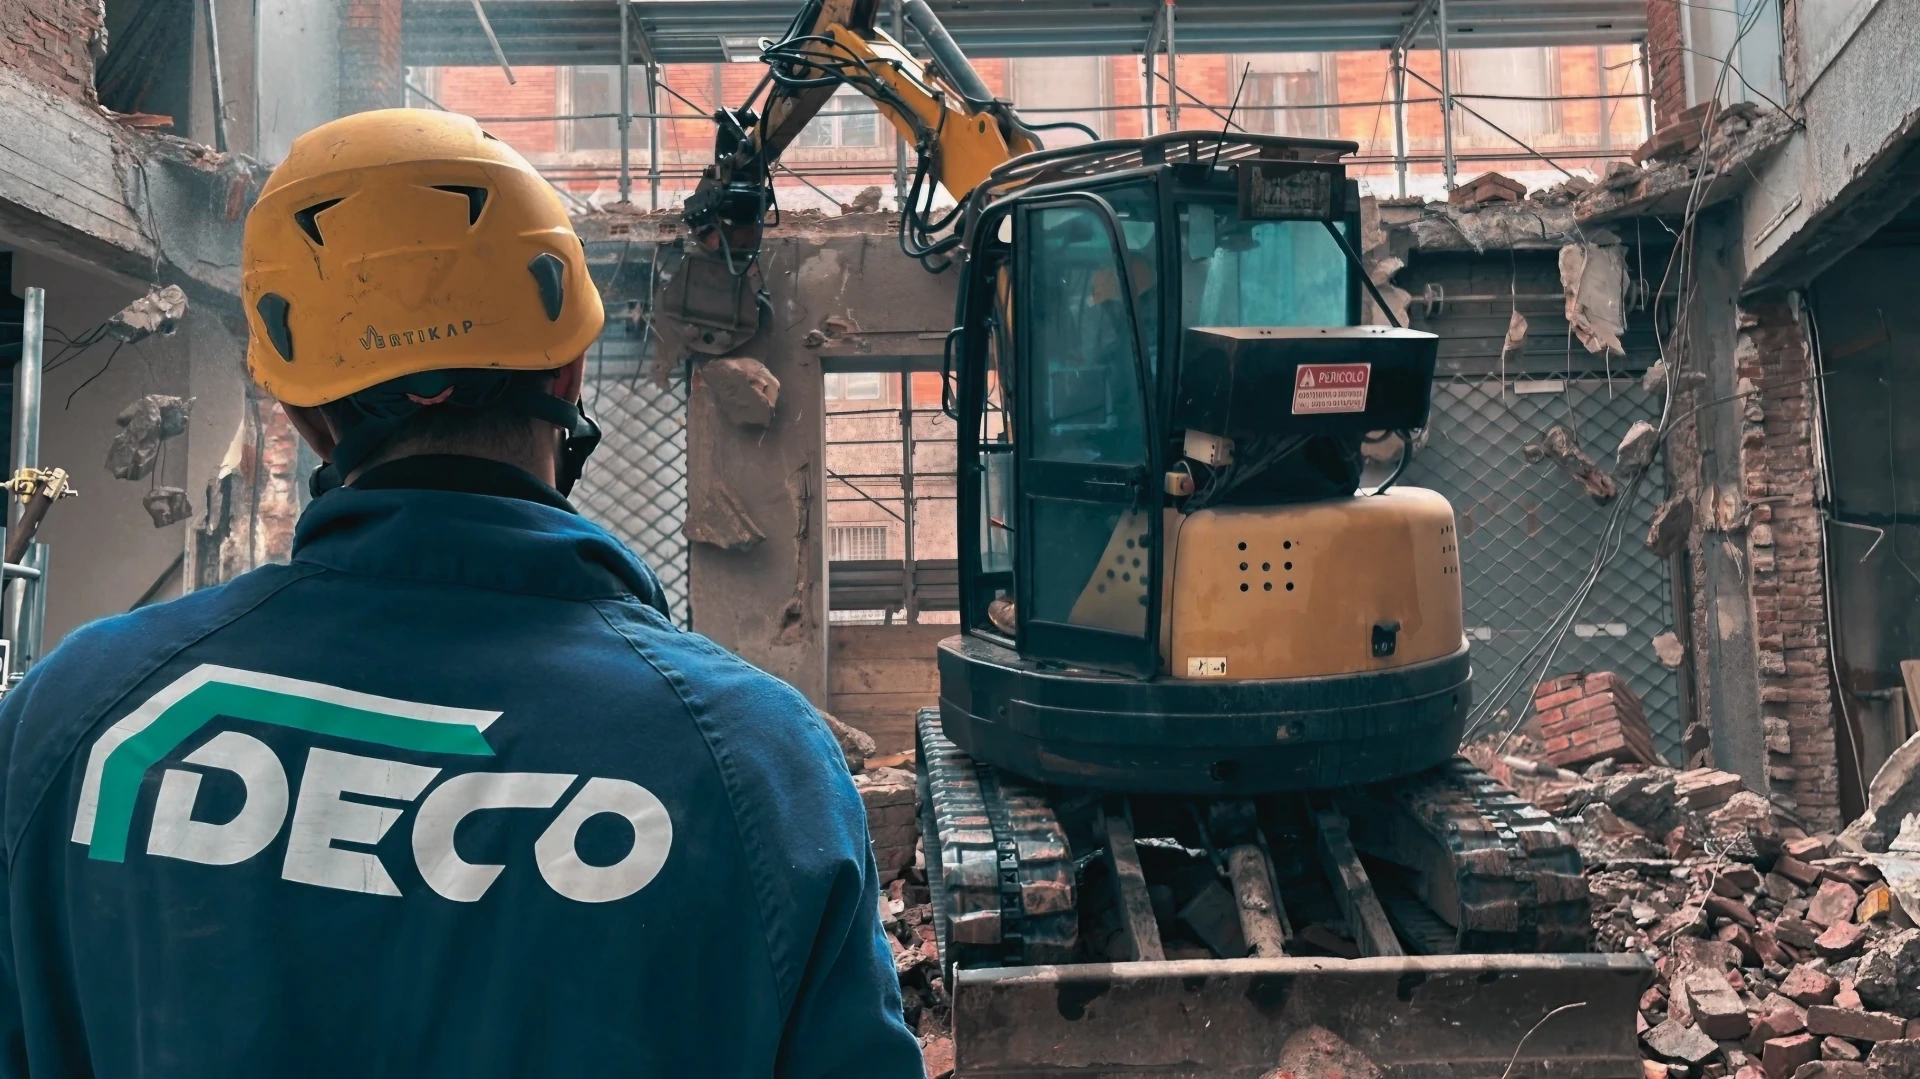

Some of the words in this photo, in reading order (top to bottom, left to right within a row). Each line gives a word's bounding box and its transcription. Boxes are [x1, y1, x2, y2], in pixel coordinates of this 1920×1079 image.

[359, 320, 473, 350] VERTIKAP
[1319, 371, 1364, 383] PERICOLO
[146, 730, 673, 903] DECO
